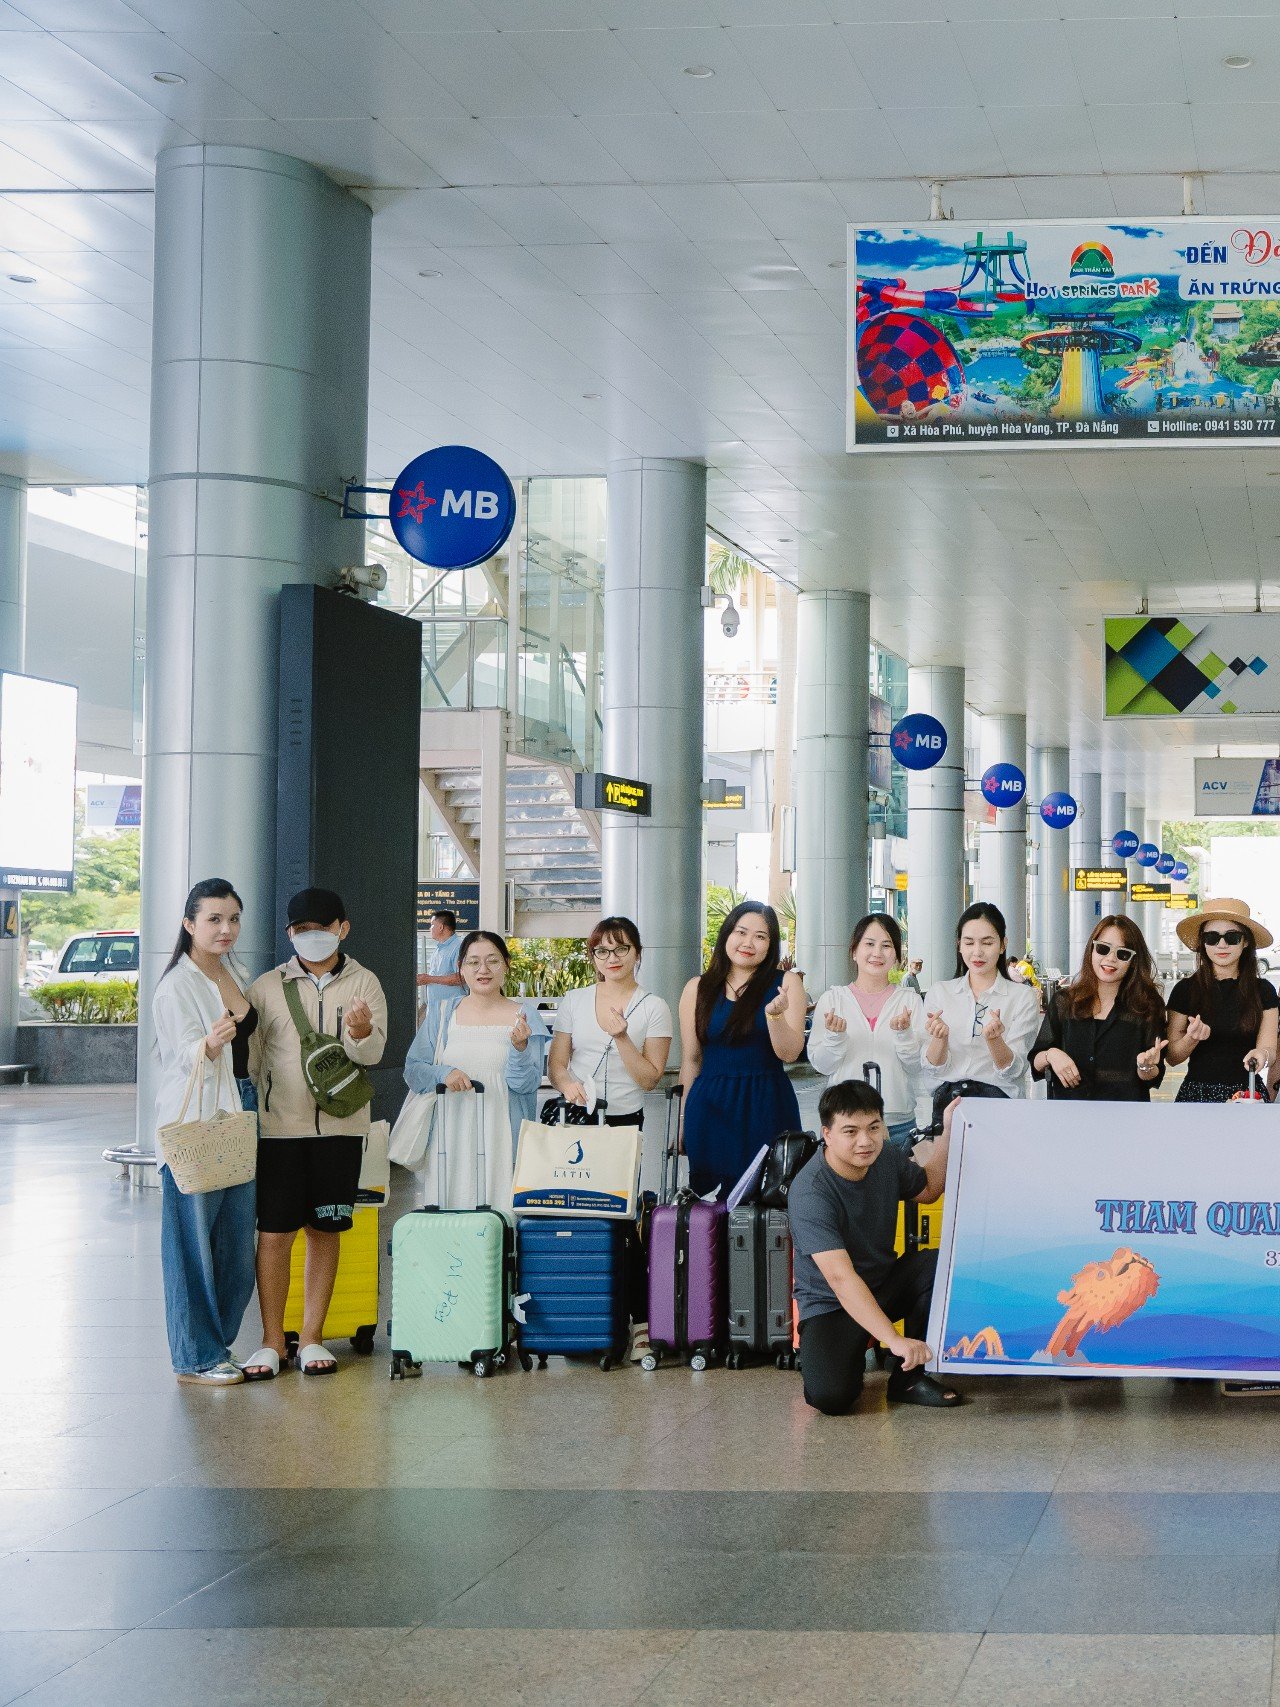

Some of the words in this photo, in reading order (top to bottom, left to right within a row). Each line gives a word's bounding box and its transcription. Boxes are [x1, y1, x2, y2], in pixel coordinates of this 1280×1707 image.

[1186, 240, 1227, 263] ĐẾN
[1121, 280, 1157, 295] PARK
[1188, 278, 1214, 295] ĂN
[904, 425, 916, 436] Xã
[920, 425, 939, 436] Hòa
[942, 423, 965, 436] Phú,
[968, 423, 998, 436] huyện
[1002, 423, 1021, 434] Hòa
[1024, 423, 1053, 435] Vang,
[1056, 422, 1072, 433] TP.
[1075, 421, 1090, 433] Đà
[1163, 420, 1201, 432] Hotline:
[1205, 421, 1230, 431] 0941
[1233, 420, 1253, 431] 530
[1256, 420, 1275, 430] 777
[440, 489, 499, 520] MB
[915, 733, 942, 749] MB
[1001, 779, 1022, 792] MB
[1203, 781, 1228, 790] ACV
[1056, 805, 1075, 816] MB
[1095, 1200, 1198, 1235] THAM
